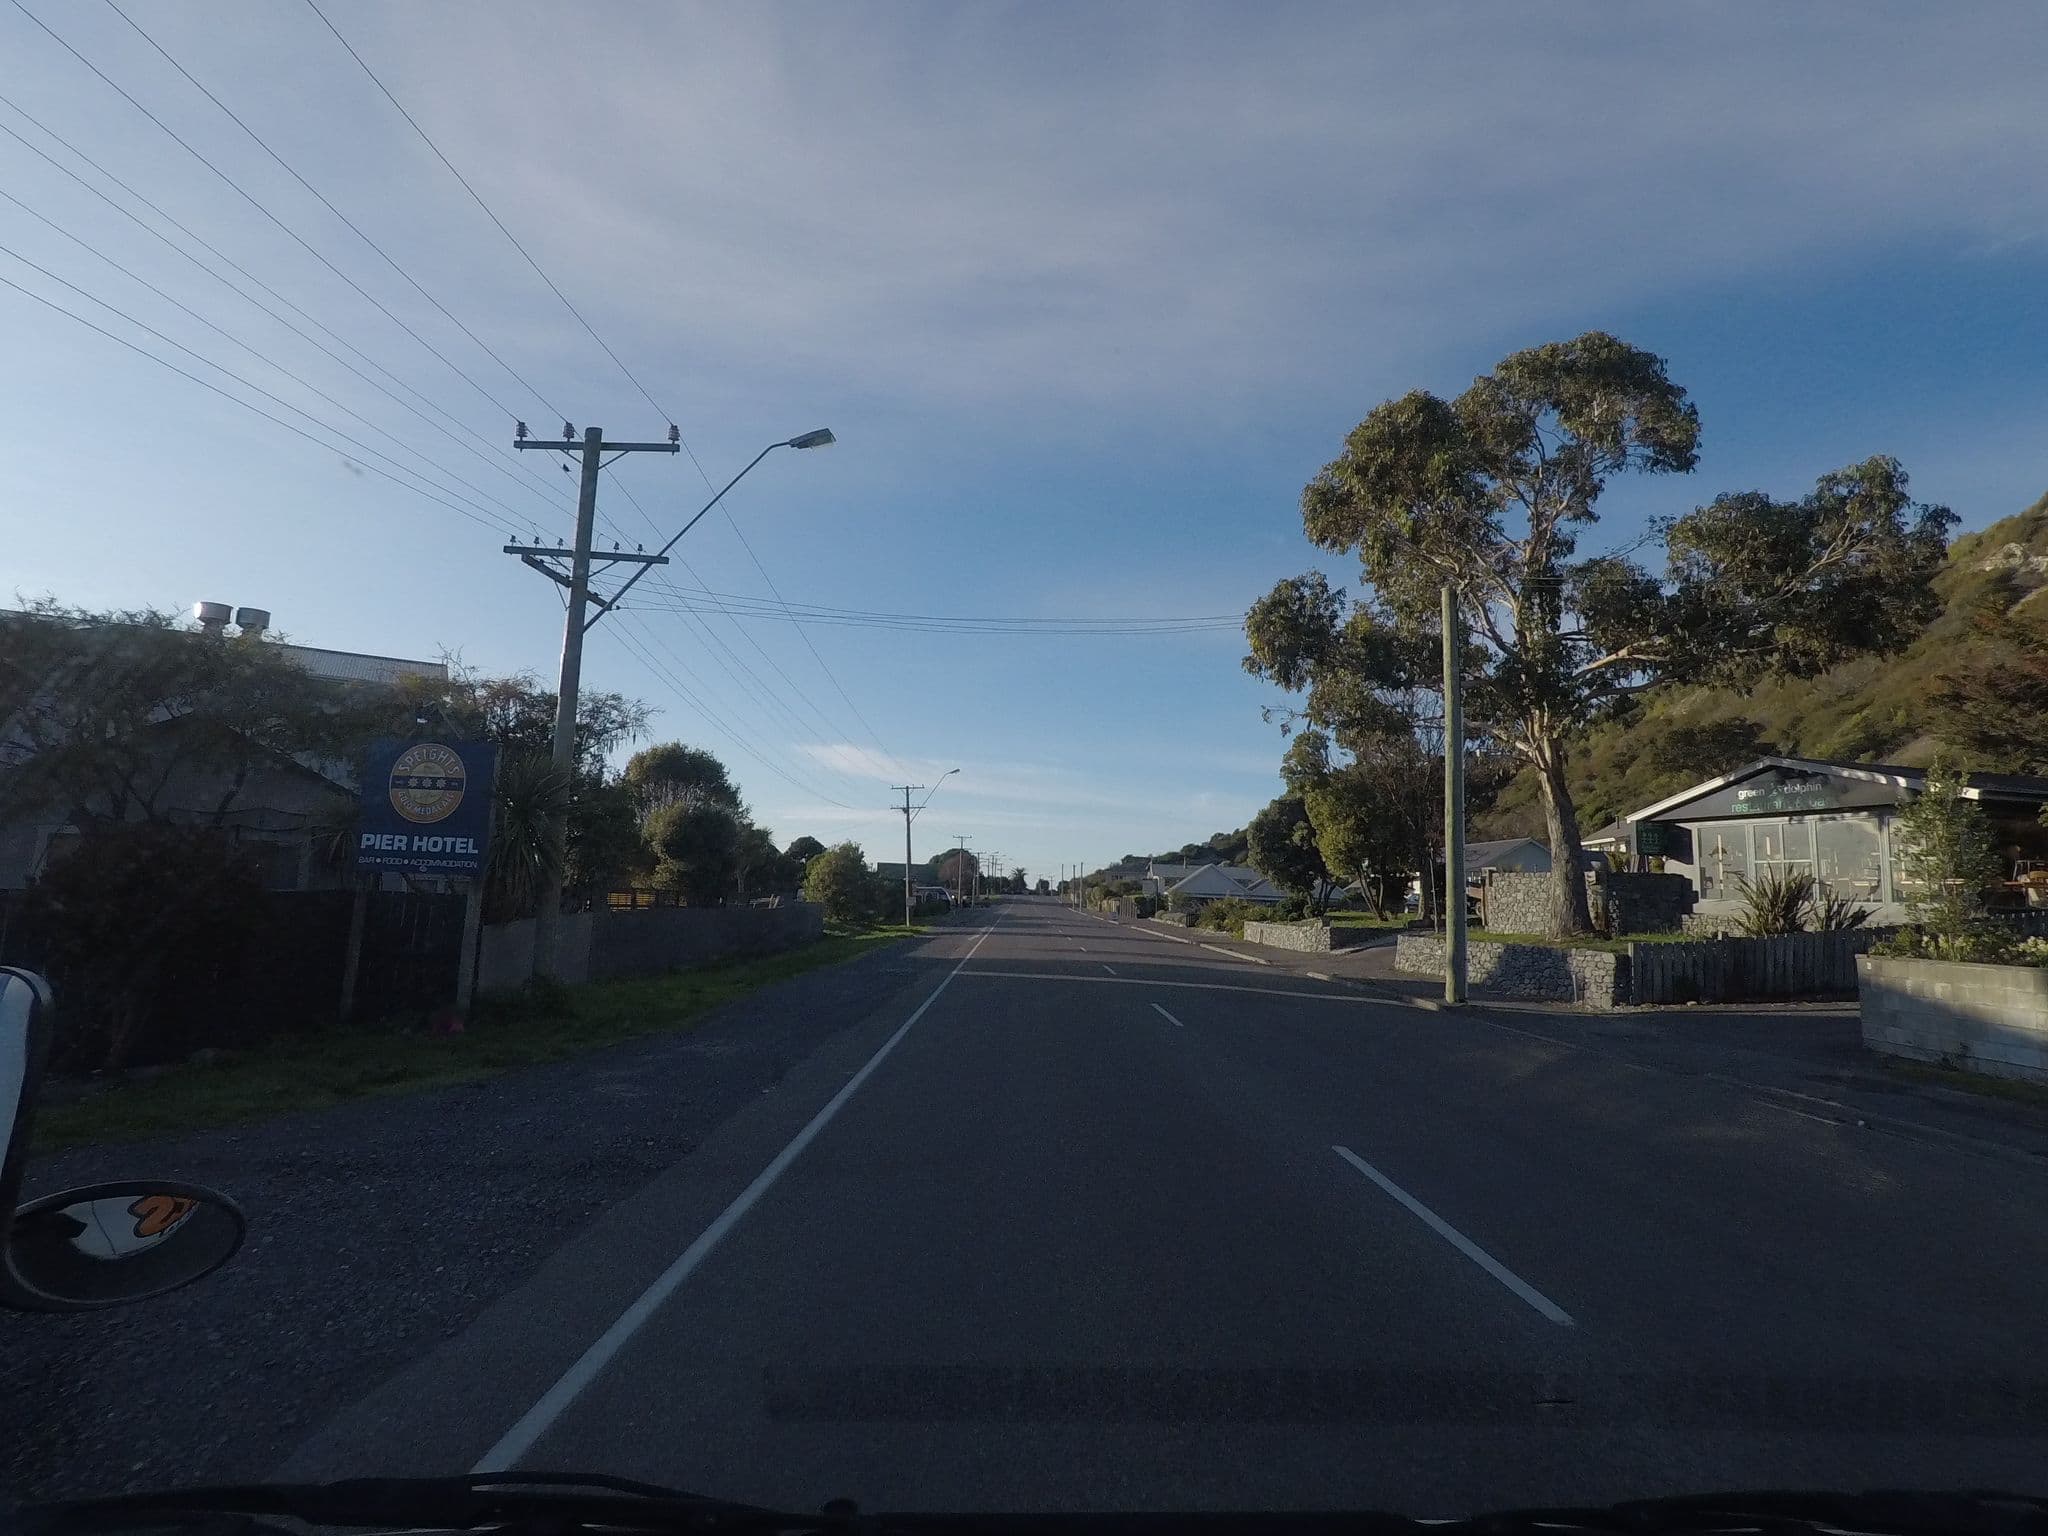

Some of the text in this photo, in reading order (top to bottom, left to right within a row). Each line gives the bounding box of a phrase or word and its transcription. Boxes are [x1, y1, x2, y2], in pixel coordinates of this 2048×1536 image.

[1737, 783, 1822, 800] green dolphin
[360, 833, 479, 854] PIER HOTEL
[358, 856, 375, 864] BAR
[382, 857, 403, 865] FOOD
